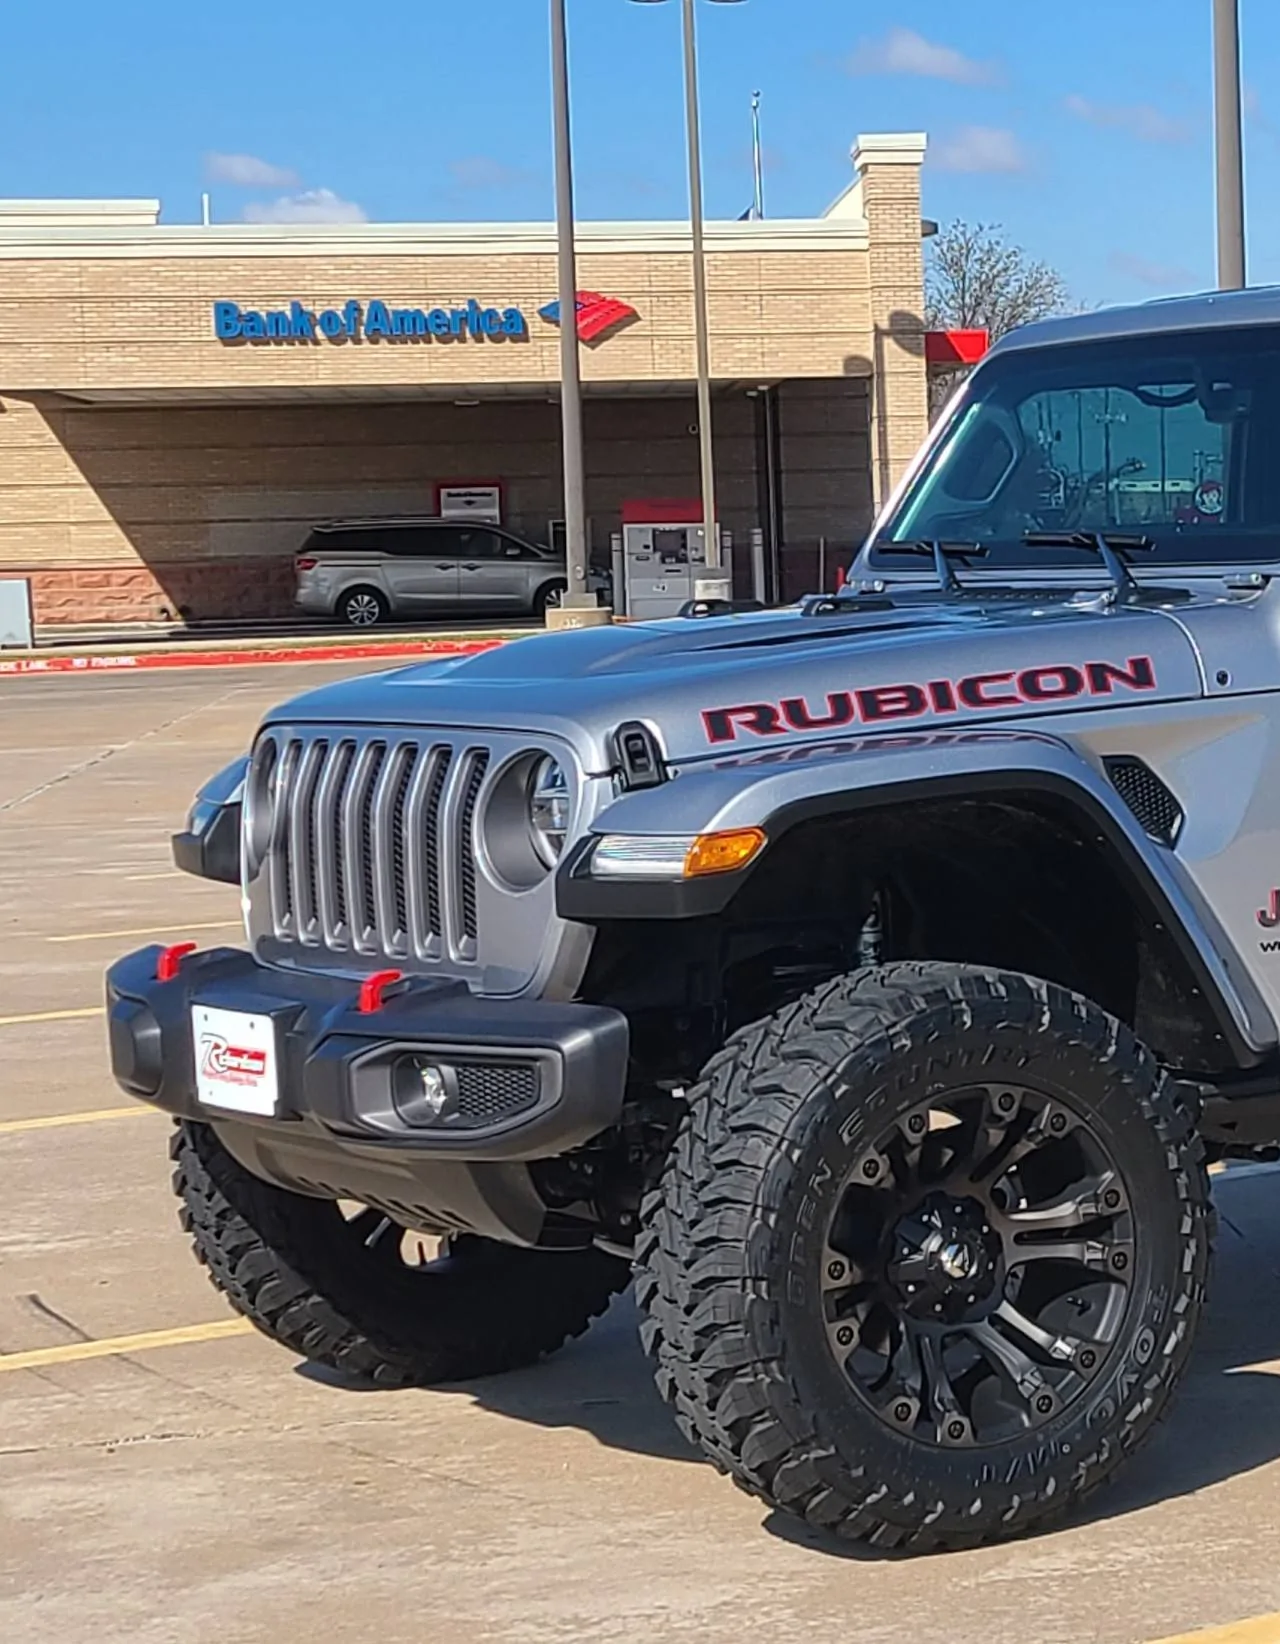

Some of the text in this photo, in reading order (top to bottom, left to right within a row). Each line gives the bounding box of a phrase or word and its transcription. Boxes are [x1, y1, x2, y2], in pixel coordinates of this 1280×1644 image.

[213, 298, 524, 339] Bank of America
[699, 655, 1158, 744] RUBICON
